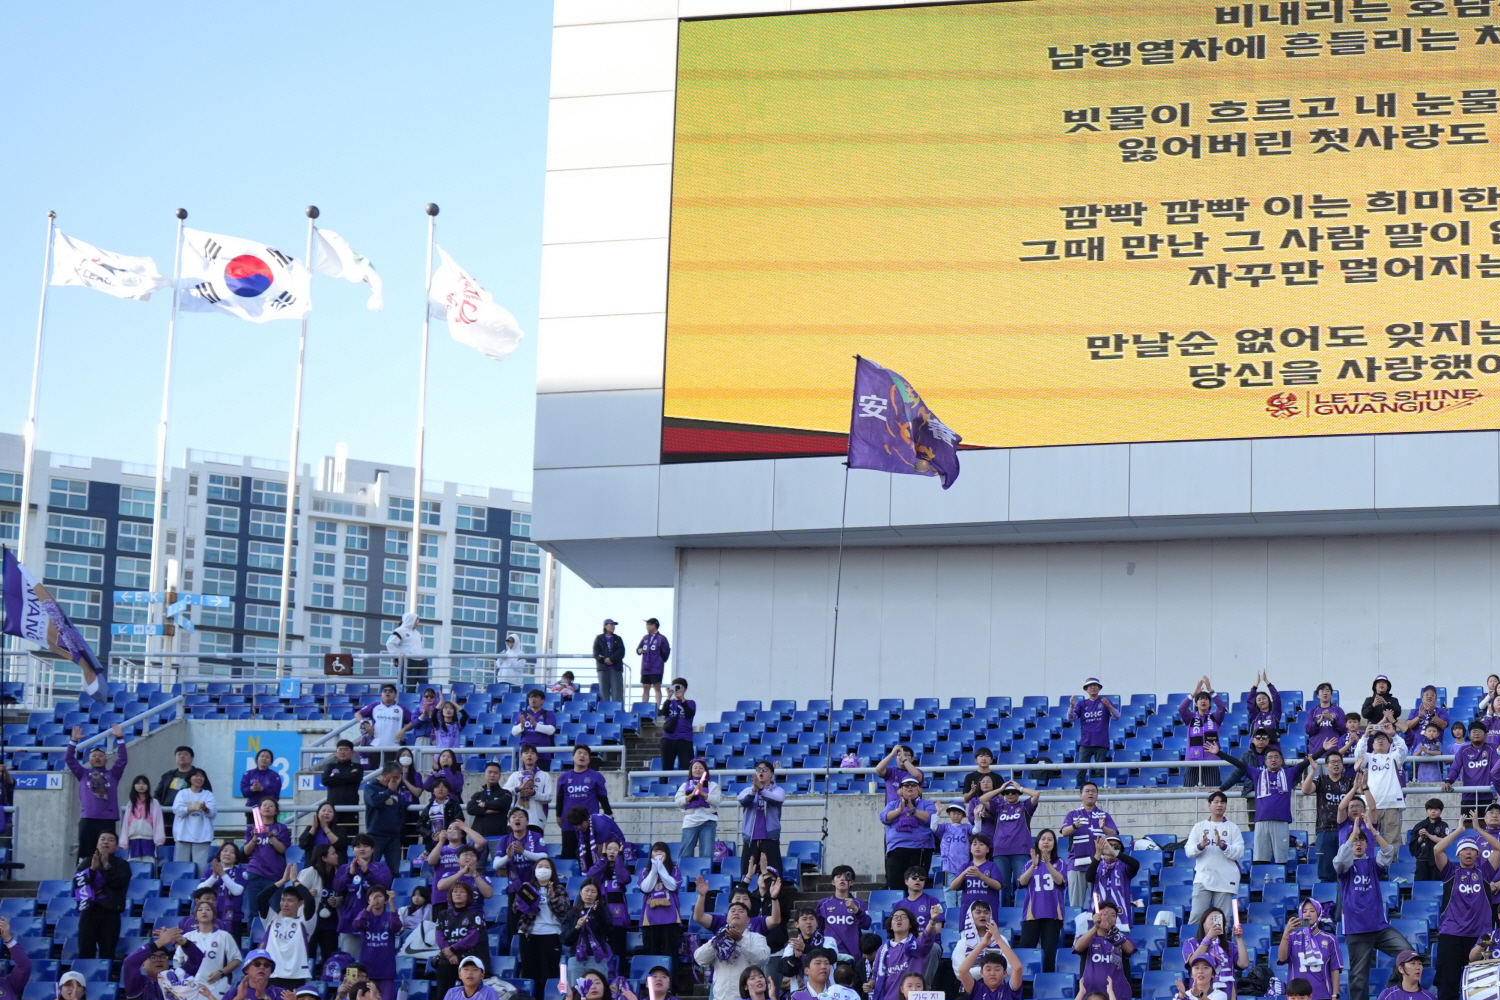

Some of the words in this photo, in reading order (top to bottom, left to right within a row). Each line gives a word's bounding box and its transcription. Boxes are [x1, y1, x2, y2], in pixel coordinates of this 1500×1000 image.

[1214, 0, 1392, 29] 비내리는
[1047, 34, 1266, 71] 남행열차에
[1280, 27, 1460, 58] 흔들리는
[1063, 102, 1190, 134] 빗물이
[1207, 97, 1340, 124] 흐르고
[1355, 92, 1396, 118] 내
[1118, 130, 1292, 163] 잃어버린
[1309, 123, 1489, 154] 첫사랑도
[1263, 194, 1351, 219] 이는
[1019, 236, 1104, 262] 그때
[1121, 231, 1209, 260] 만난
[1222, 230, 1264, 252] 그
[1279, 224, 1370, 252] 사람
[1385, 220, 1470, 249] 말이
[1188, 259, 1324, 289] 자꾸만
[1087, 331, 1218, 361] 만날순
[1235, 325, 1368, 354] 없어도
[1189, 360, 1322, 390] 당신을
[1314, 391, 1388, 405] LET'S
[1393, 389, 1480, 403] SHINE
[858, 395, 888, 422] 安
[1314, 401, 1445, 417] GWANGJU
[286, 681, 294, 693] J
[1084, 710, 1103, 719] OHC
[248, 736, 260, 752] N
[1468, 759, 1489, 770] OHC
[50, 777, 59, 786] N
[302, 777, 311, 787] N
[567, 785, 590, 794] OHC
[1000, 813, 1021, 822] OHC
[256, 836, 272, 846] OH
[946, 834, 967, 844] OHC
[1034, 873, 1054, 891] 13
[1458, 882, 1482, 894] OHC
[827, 915, 855, 925] OHC
